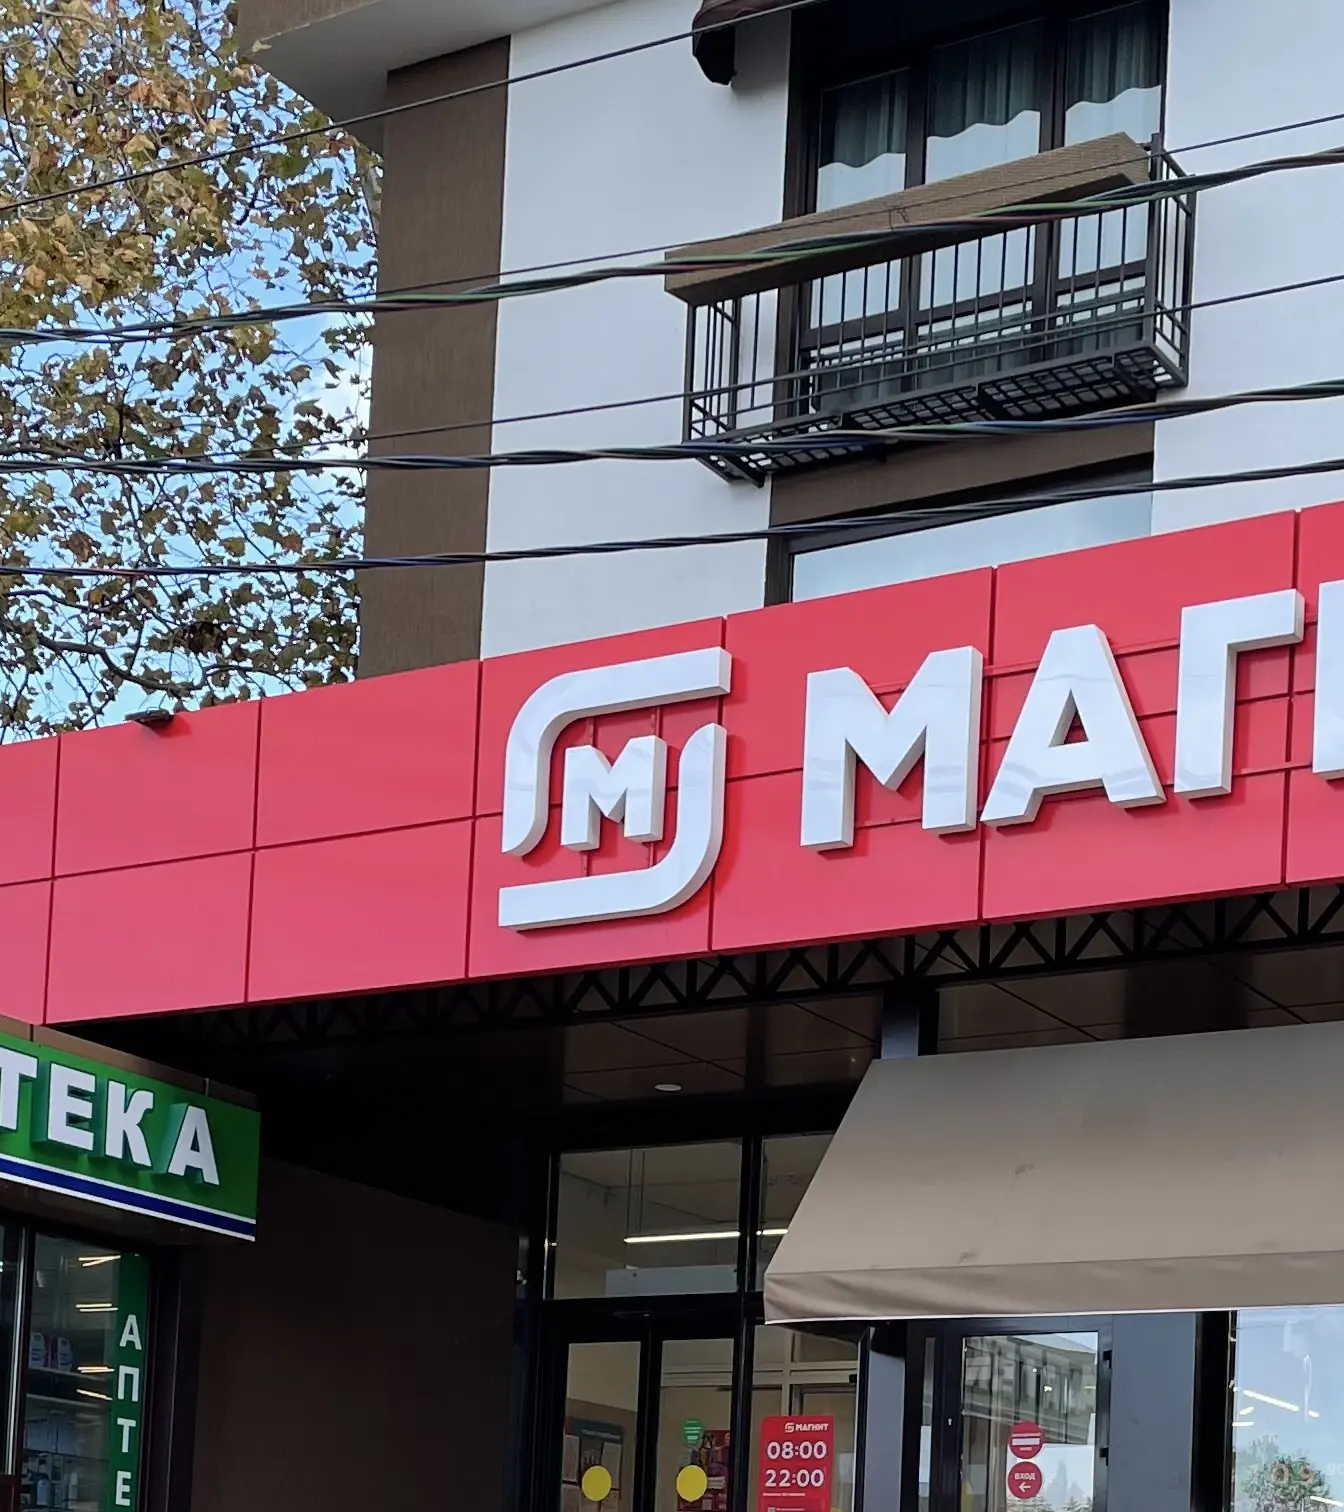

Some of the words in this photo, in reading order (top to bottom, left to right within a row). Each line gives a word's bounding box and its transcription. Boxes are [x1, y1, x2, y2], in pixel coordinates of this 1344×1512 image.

[795, 1423, 829, 1432] МАГНИТ
[767, 1441, 827, 1459] 08:00
[765, 1469, 825, 1487] 22:00
[1014, 1472, 1036, 1481] ВХОД
